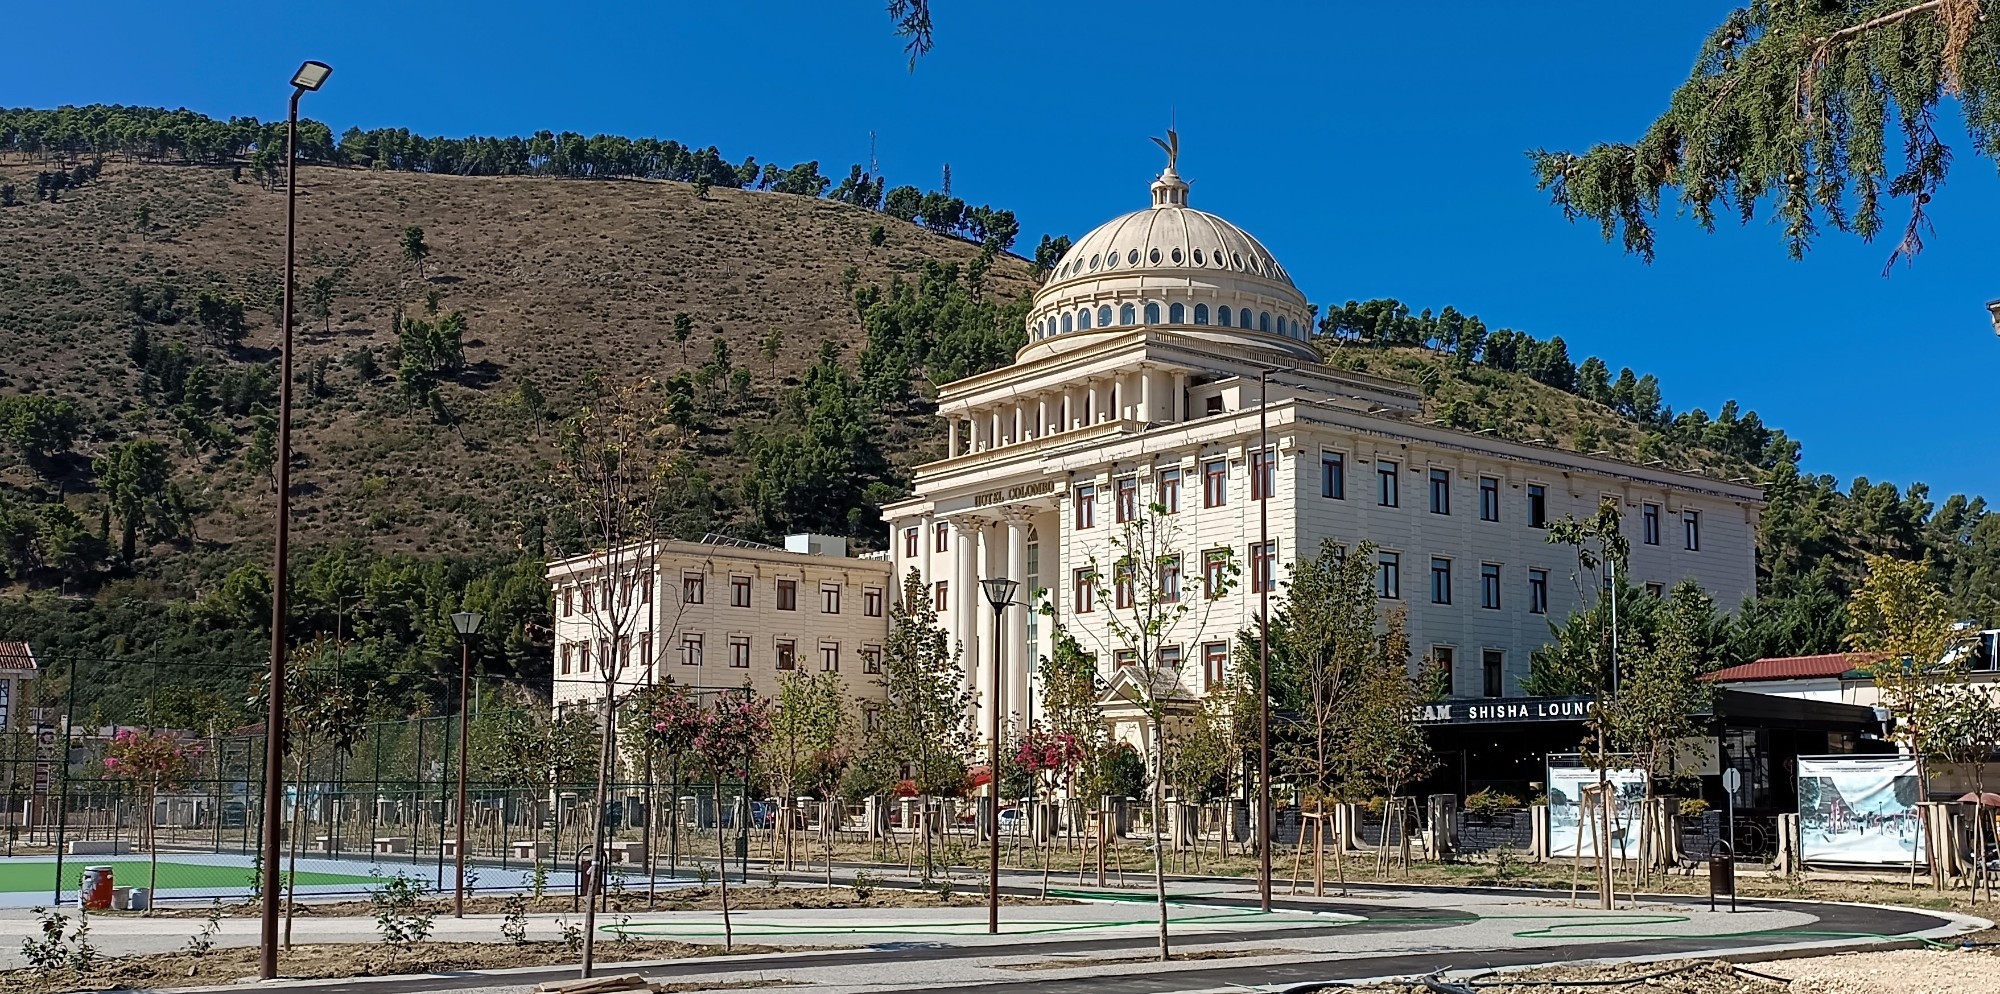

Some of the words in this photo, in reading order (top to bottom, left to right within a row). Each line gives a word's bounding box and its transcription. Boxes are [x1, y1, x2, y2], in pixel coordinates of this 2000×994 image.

[975, 491, 1004, 507] HOTEL
[1009, 480, 1055, 500] COLOMBO
[1469, 704, 1529, 719] SHISHA
[1538, 701, 1608, 717] LOUN
